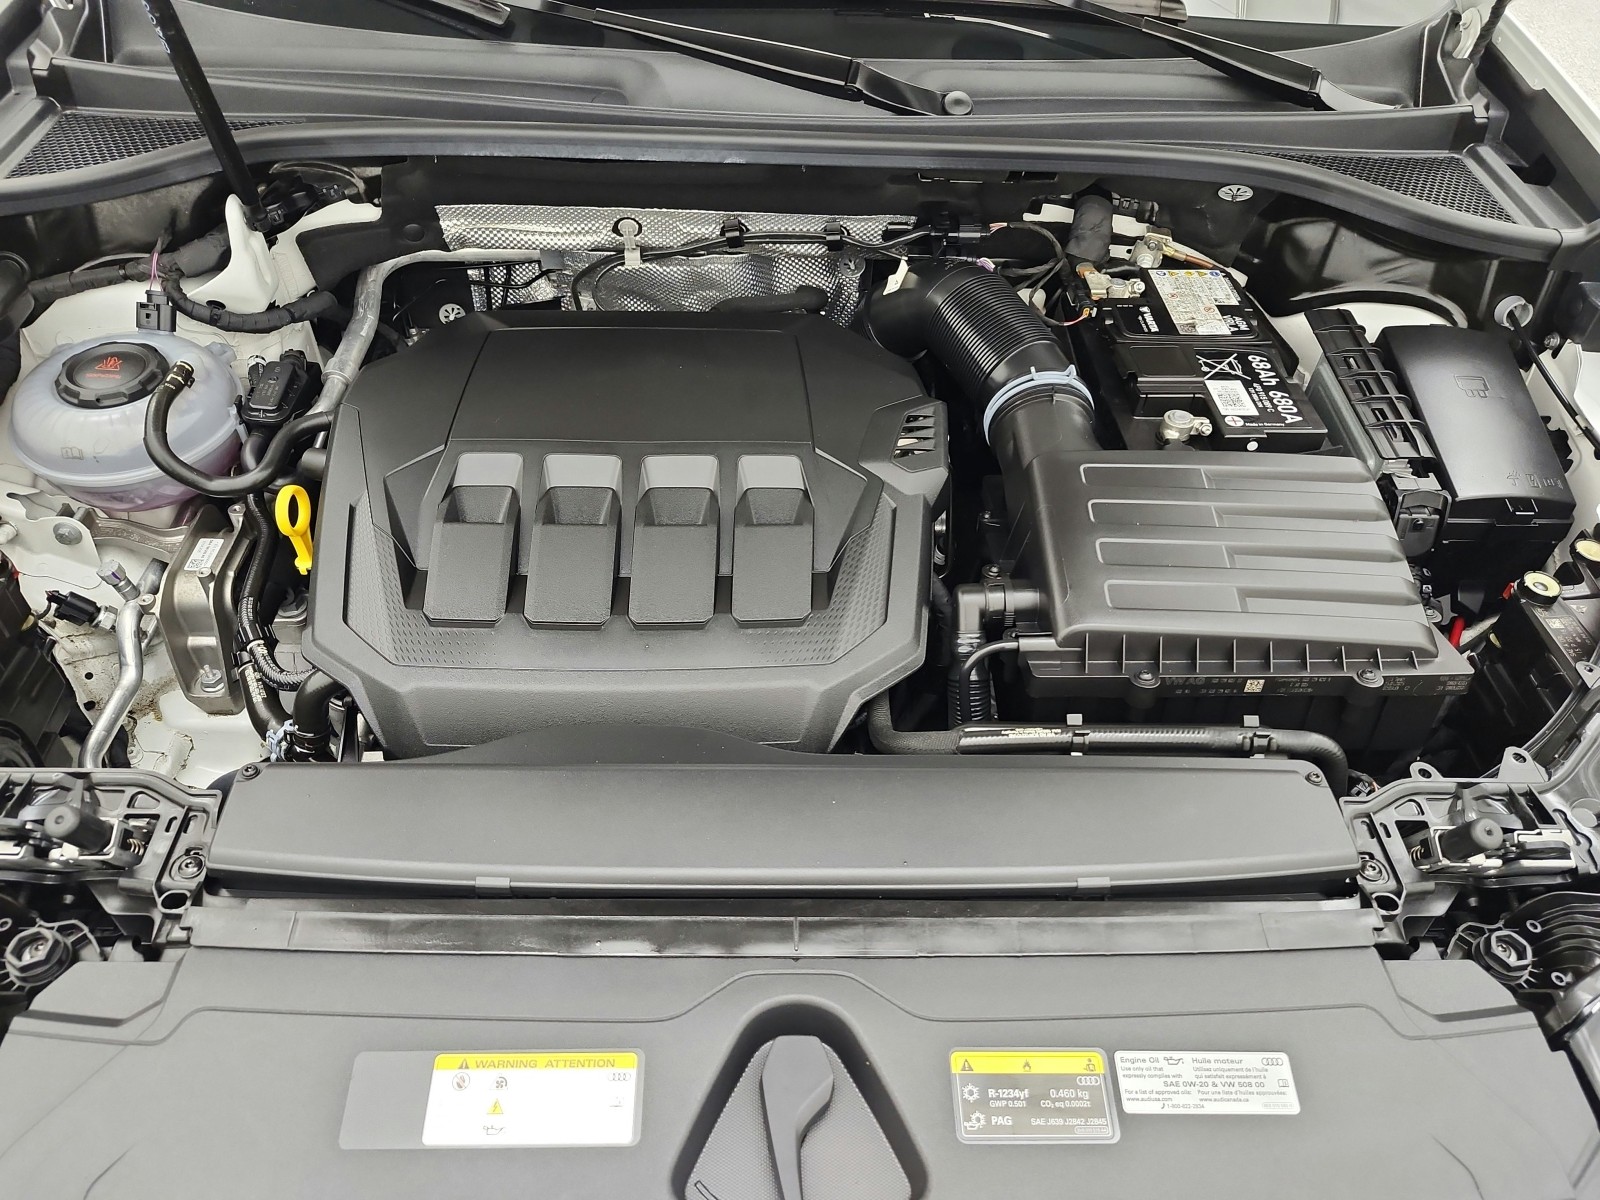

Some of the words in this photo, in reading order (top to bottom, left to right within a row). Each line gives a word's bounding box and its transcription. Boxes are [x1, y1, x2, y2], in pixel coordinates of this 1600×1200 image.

[1143, 312, 1160, 333] VARTA
[1232, 315, 1251, 331] AGM
[1247, 355, 1280, 386] 68Ah
[1268, 390, 1303, 424] 680A
[475, 1059, 538, 1069] WARNING
[544, 1058, 616, 1068] ATTENTION
[988, 1088, 1030, 1099] R-1234yf
[1050, 1089, 1076, 1098] 0.460
[1077, 1089, 1089, 1100] kg
[991, 1116, 1012, 1125] PAG
